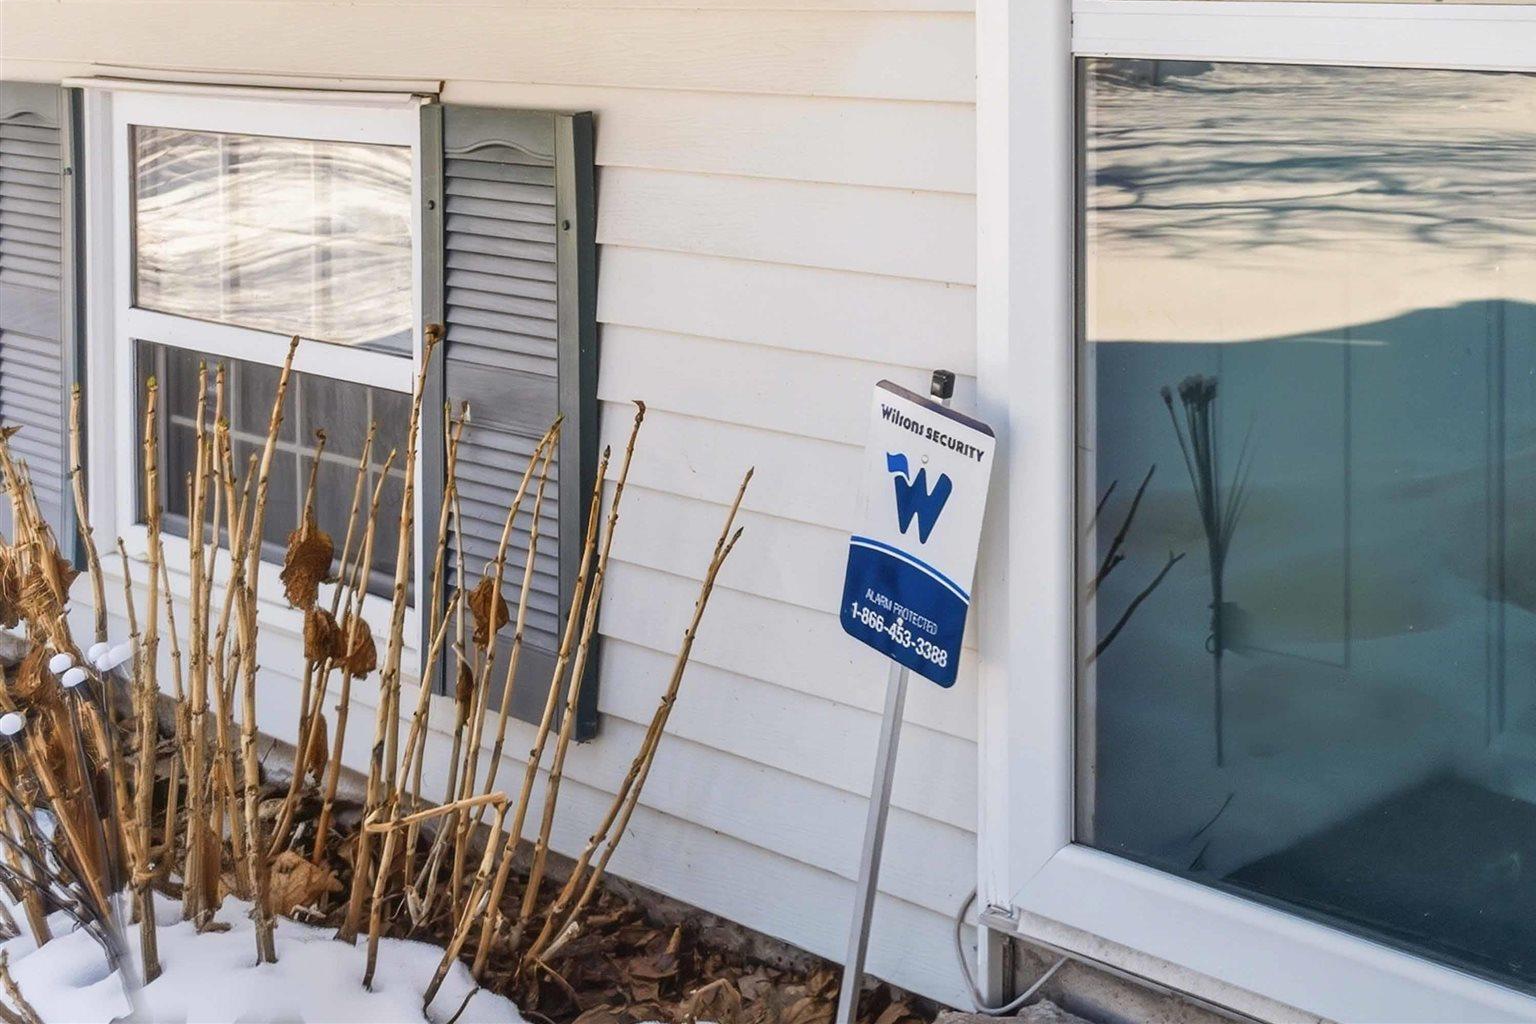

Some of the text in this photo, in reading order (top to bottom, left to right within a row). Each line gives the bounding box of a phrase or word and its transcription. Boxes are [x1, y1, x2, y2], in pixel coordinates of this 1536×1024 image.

[881, 403, 985, 462] Wilsons SECURITY
[894, 467, 953, 545] W
[851, 601, 948, 668] 1-866-453-3388
[865, 588, 938, 635] ALARM PROTECTED
